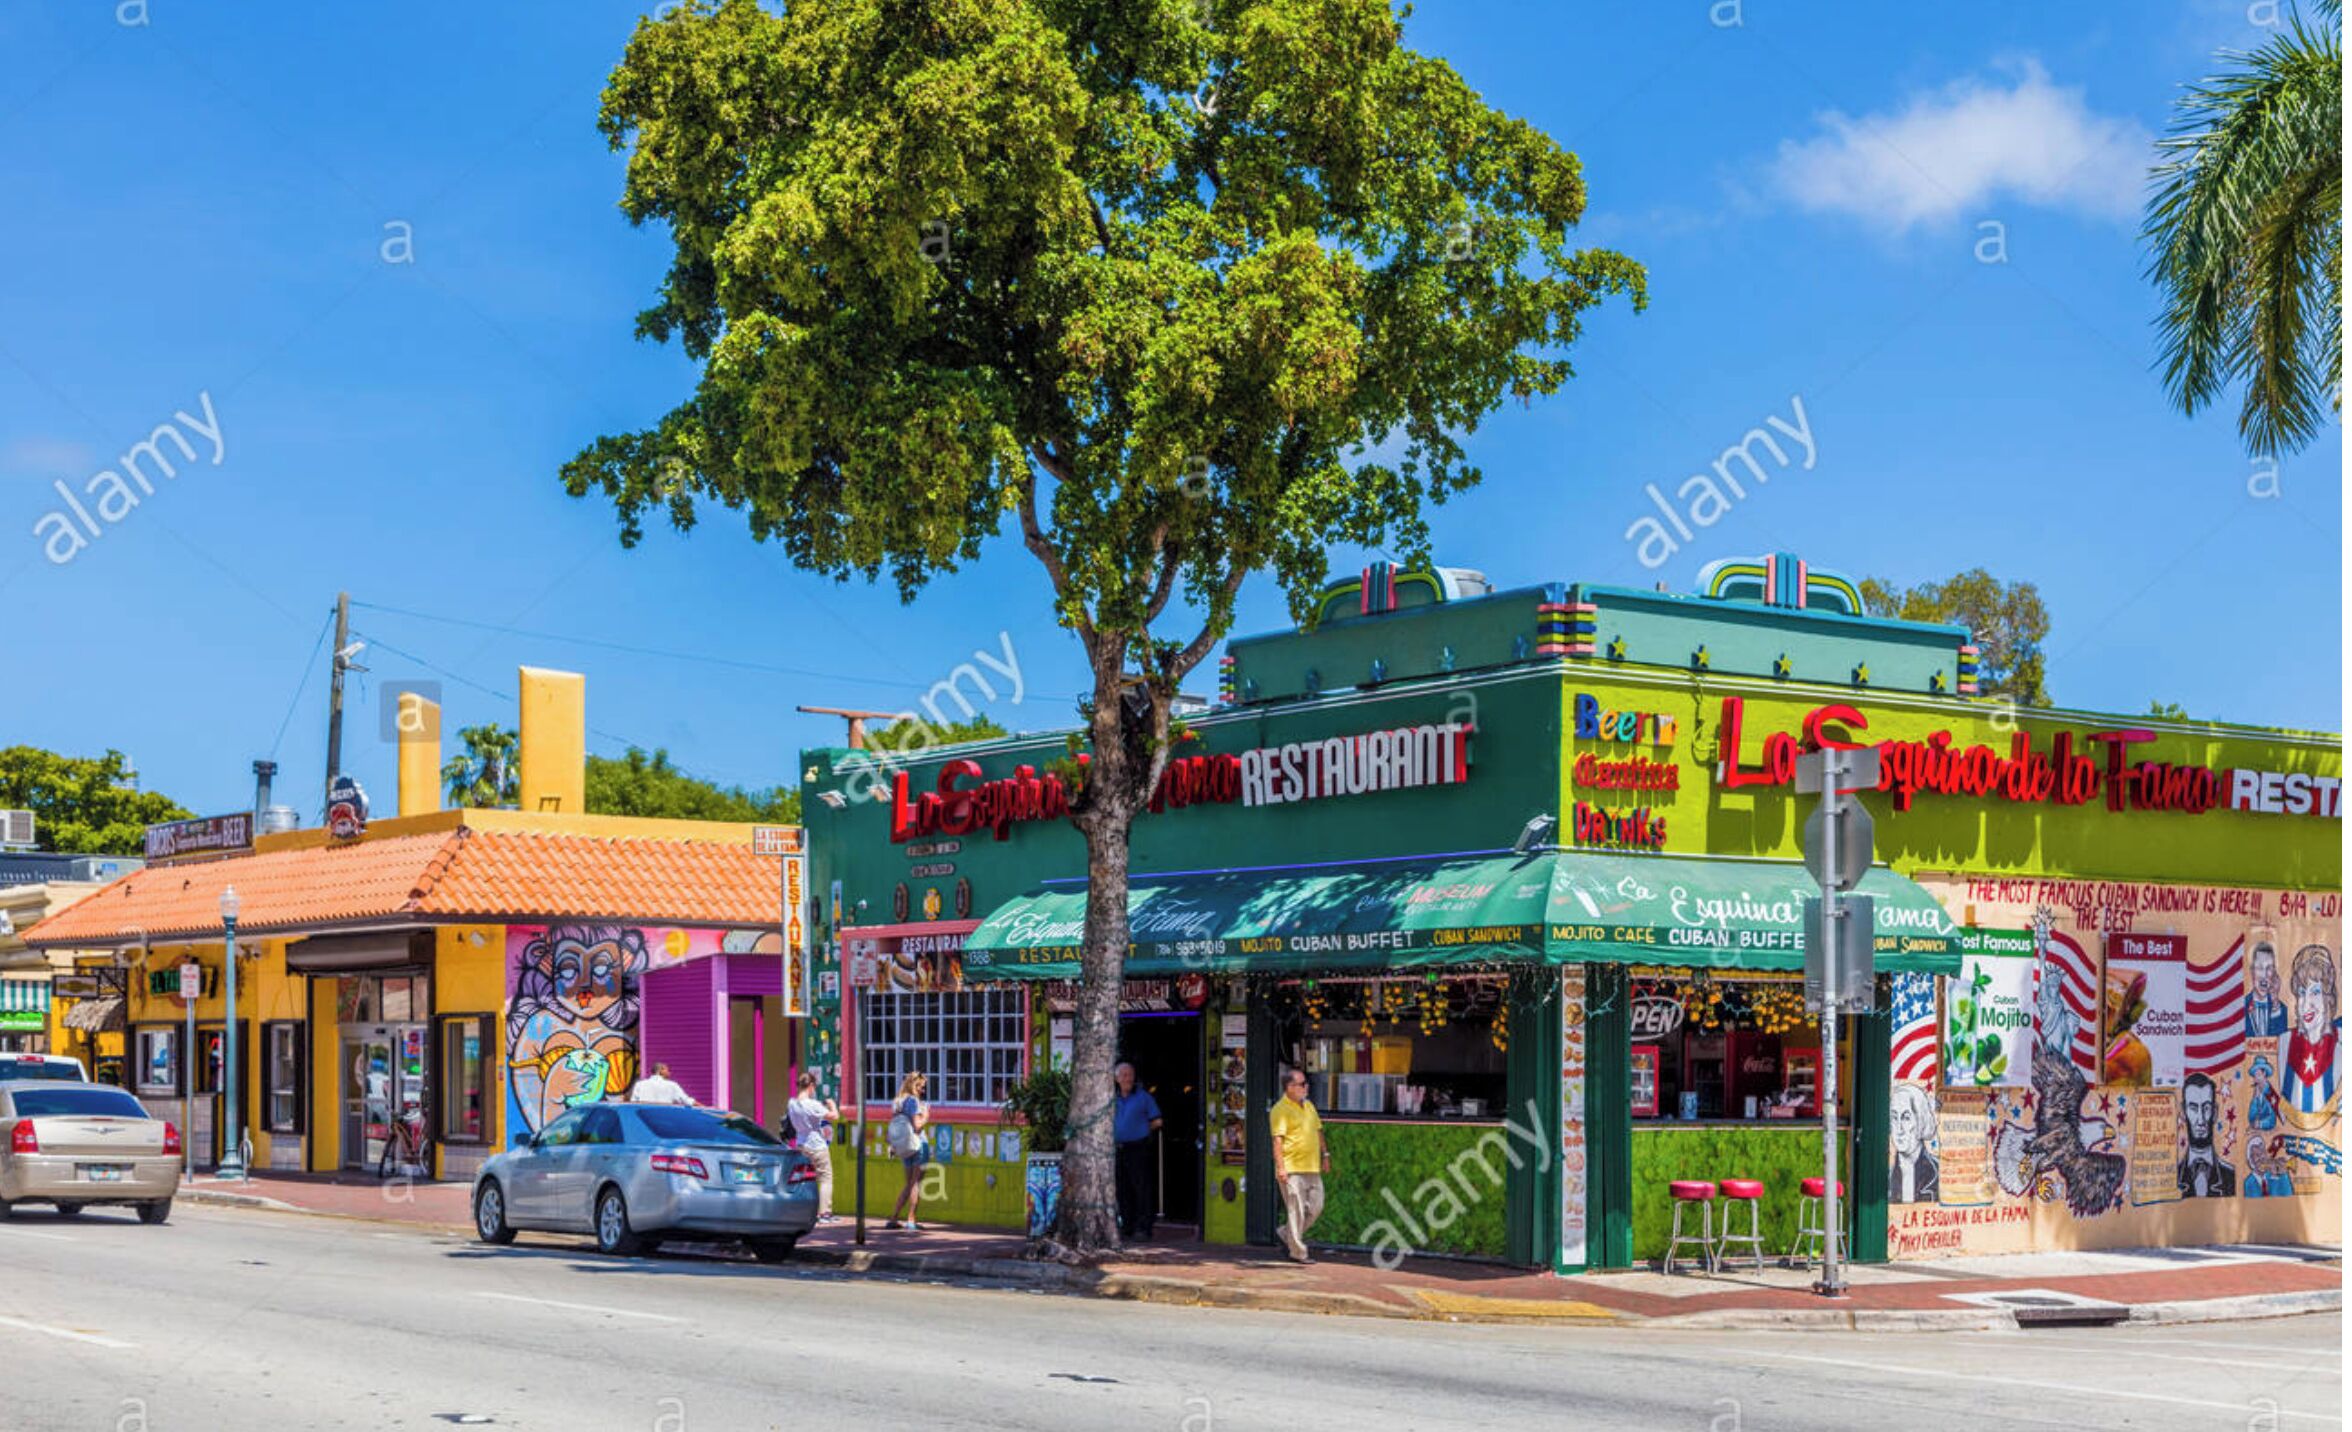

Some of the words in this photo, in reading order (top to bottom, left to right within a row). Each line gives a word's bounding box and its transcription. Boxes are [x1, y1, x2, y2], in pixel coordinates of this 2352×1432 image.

[1574, 693, 1650, 743] Beer
[1241, 722, 1468, 807] RESTAURANT
[1717, 696, 1798, 788] La
[2006, 731, 2054, 802] de
[2052, 731, 2102, 806] la
[2086, 729, 2221, 815] Fama
[1574, 751, 1680, 791] Cantina
[890, 770, 942, 844] La
[1150, 752, 1243, 814] ama
[223, 815, 247, 848] BEER
[1669, 885, 1800, 929] Esquina
[1967, 879, 1996, 902] THE
[1999, 880, 2035, 904] MOST
[2038, 881, 2094, 907] FAMOUS
[2098, 882, 2139, 908] CUBAN
[2141, 885, 2199, 914] SANDWICH
[2203, 889, 2216, 913] IS
[1241, 937, 1281, 953] MOJITO
[1291, 935, 1342, 952] CUBAN
[1348, 931, 1414, 950] BUFFET
[1433, 928, 1465, 946] CUBAN
[1468, 926, 1522, 944] SANDWICH
[1552, 925, 1605, 941] MOJITO
[1668, 928, 1730, 947] CUBAN
[1740, 930, 1805, 950] BUFFE
[1874, 935, 1898, 950] UBAN
[1962, 936, 1980, 949] ost
[1984, 935, 2031, 952] Famous
[2123, 938, 2143, 954] The
[2147, 940, 2172, 956] Best
[1993, 995, 2019, 1004] Cuban
[1631, 1005, 1676, 1033] PEN
[1981, 1007, 2031, 1032] Mojito
[2147, 1009, 2184, 1022] Cuban
[2136, 1023, 2183, 1036] Sandwich
[1902, 1211, 1918, 1228] LA
[1922, 1209, 1967, 1227] ESQUINA
[1972, 1208, 1983, 1224] DE
[1985, 1207, 1998, 1223] LA
[2001, 1205, 2030, 1223] FAMA
